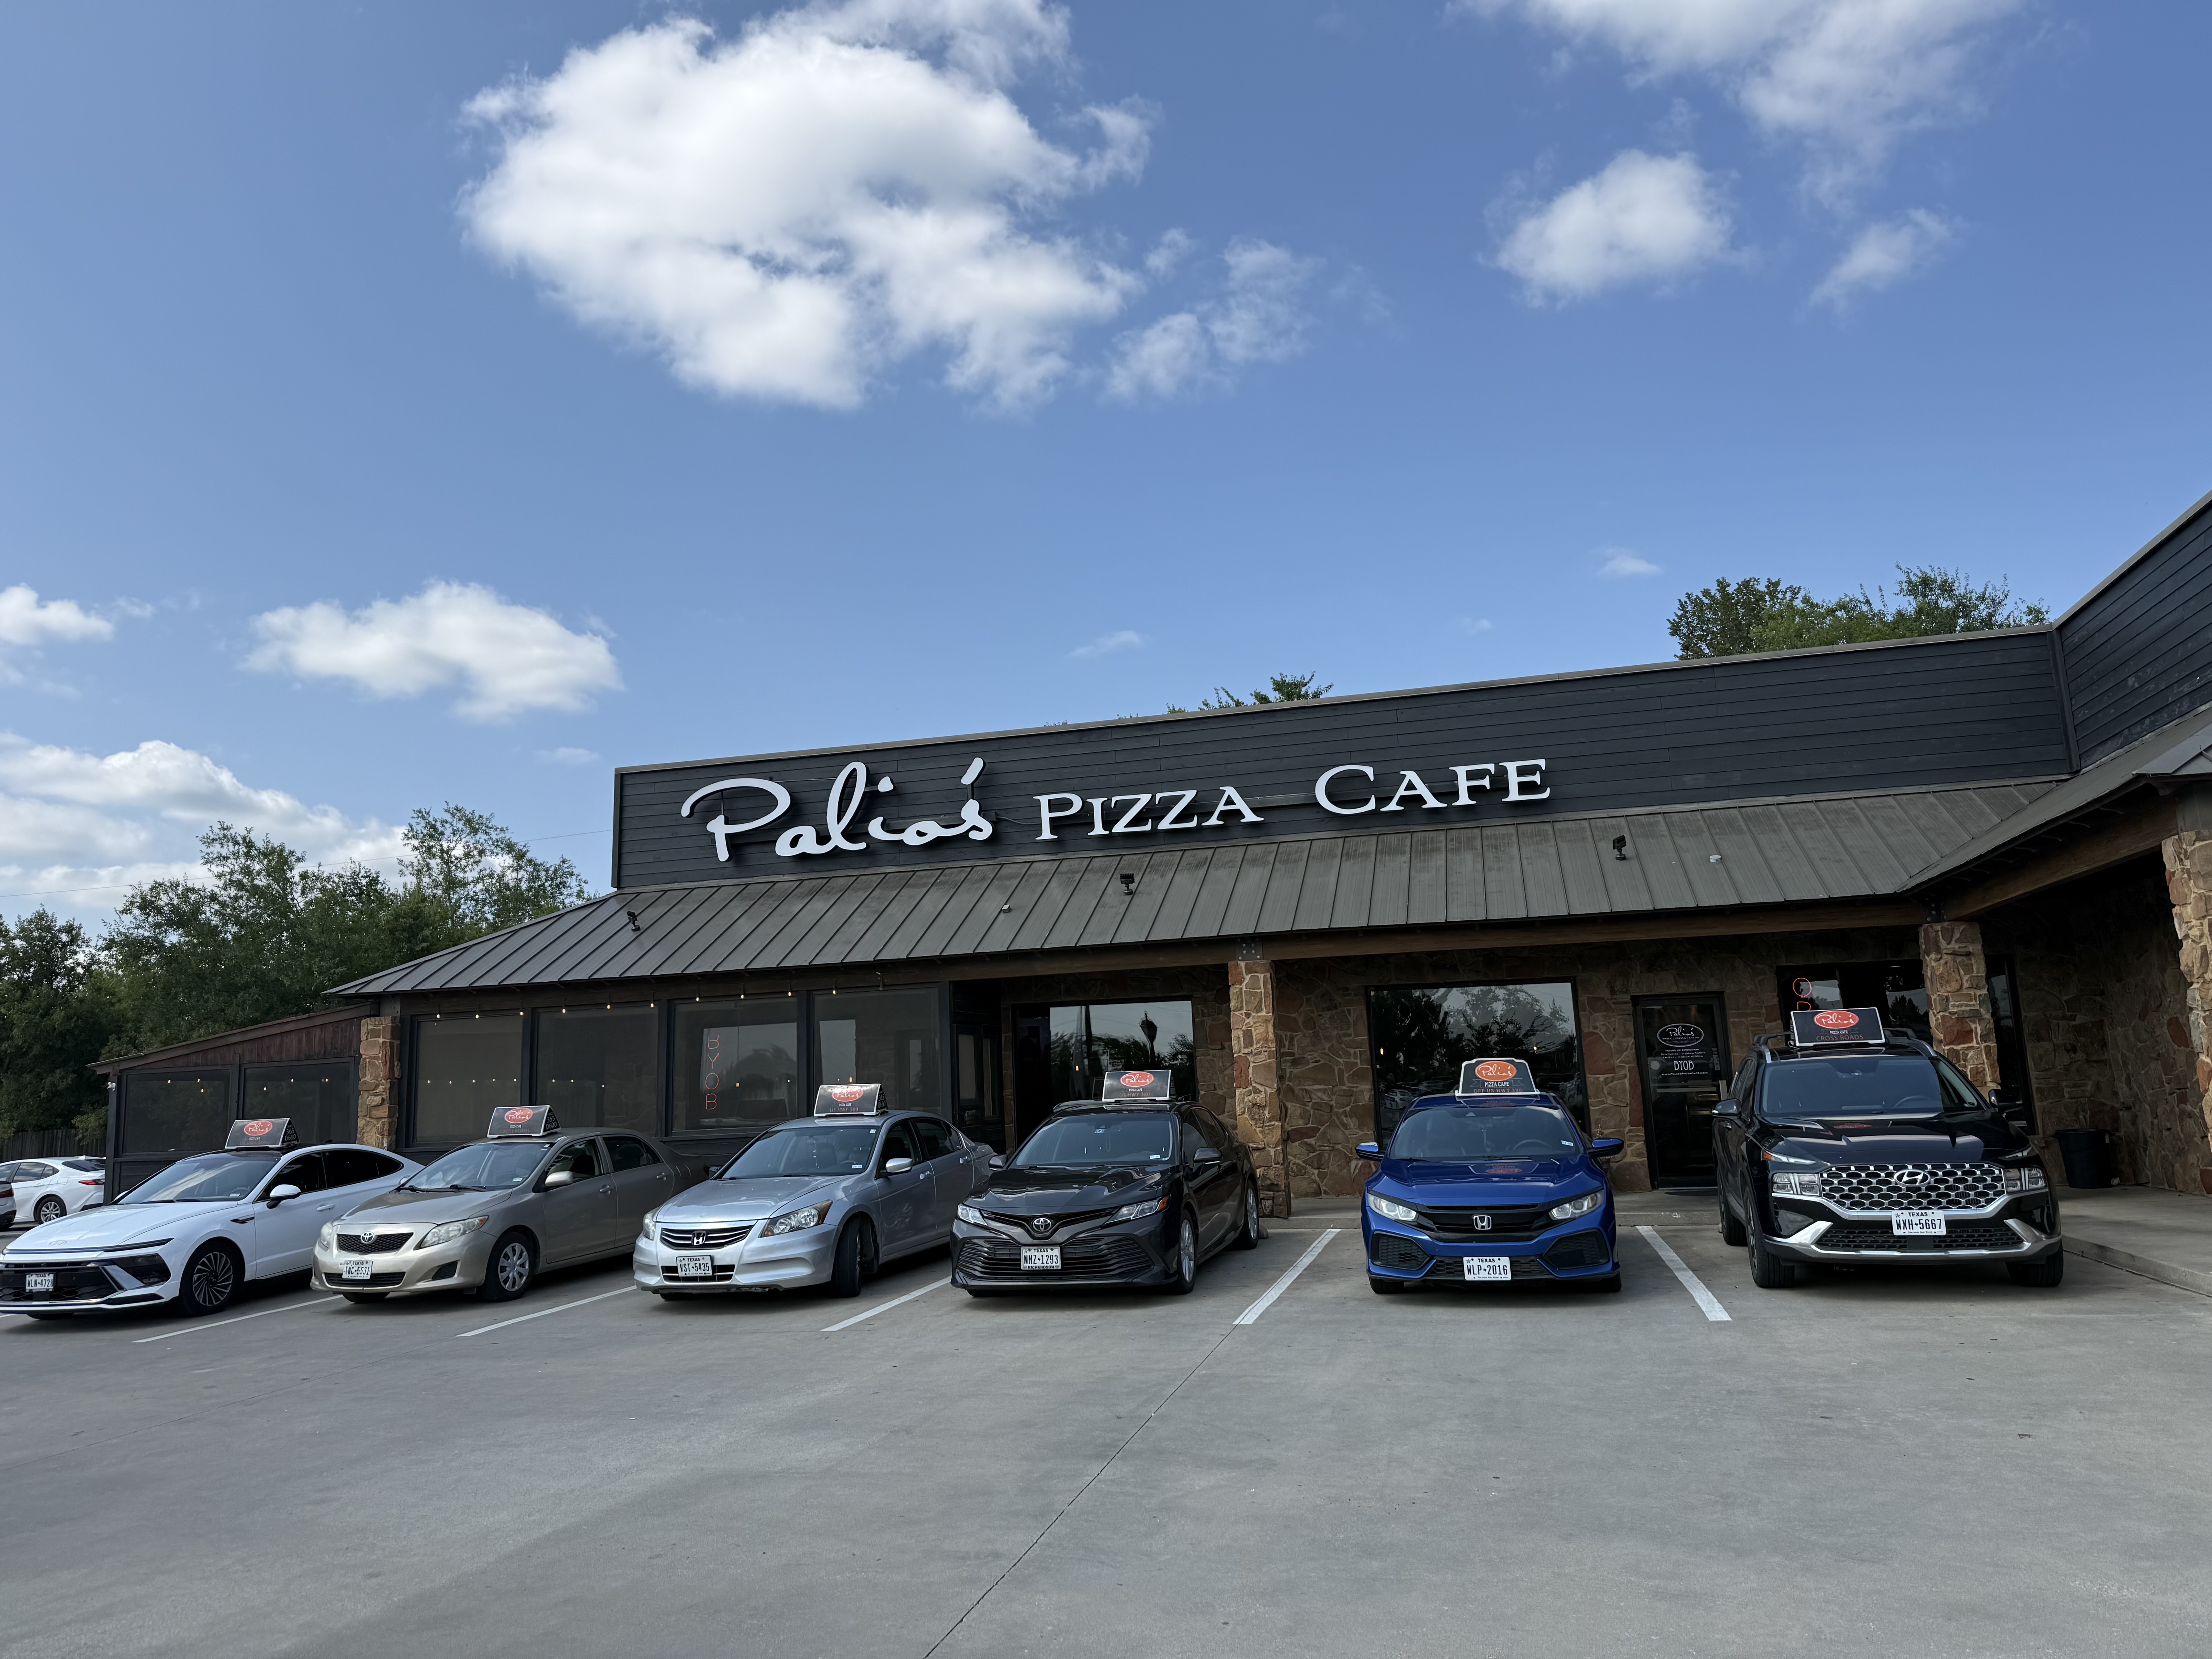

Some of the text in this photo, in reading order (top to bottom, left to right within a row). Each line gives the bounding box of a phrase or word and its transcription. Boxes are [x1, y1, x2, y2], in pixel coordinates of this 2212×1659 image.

[681, 757, 1551, 862] Palio's PIZZA CAFE
[1817, 1013, 1854, 1024] Palio's
[1666, 1026, 1694, 1037] Palio's
[1479, 1064, 1512, 1076] Palio's
[1674, 1060, 1694, 1070] BYOB
[1123, 1074, 1150, 1084] Palio's
[546, 1121, 557, 1130] 0600
